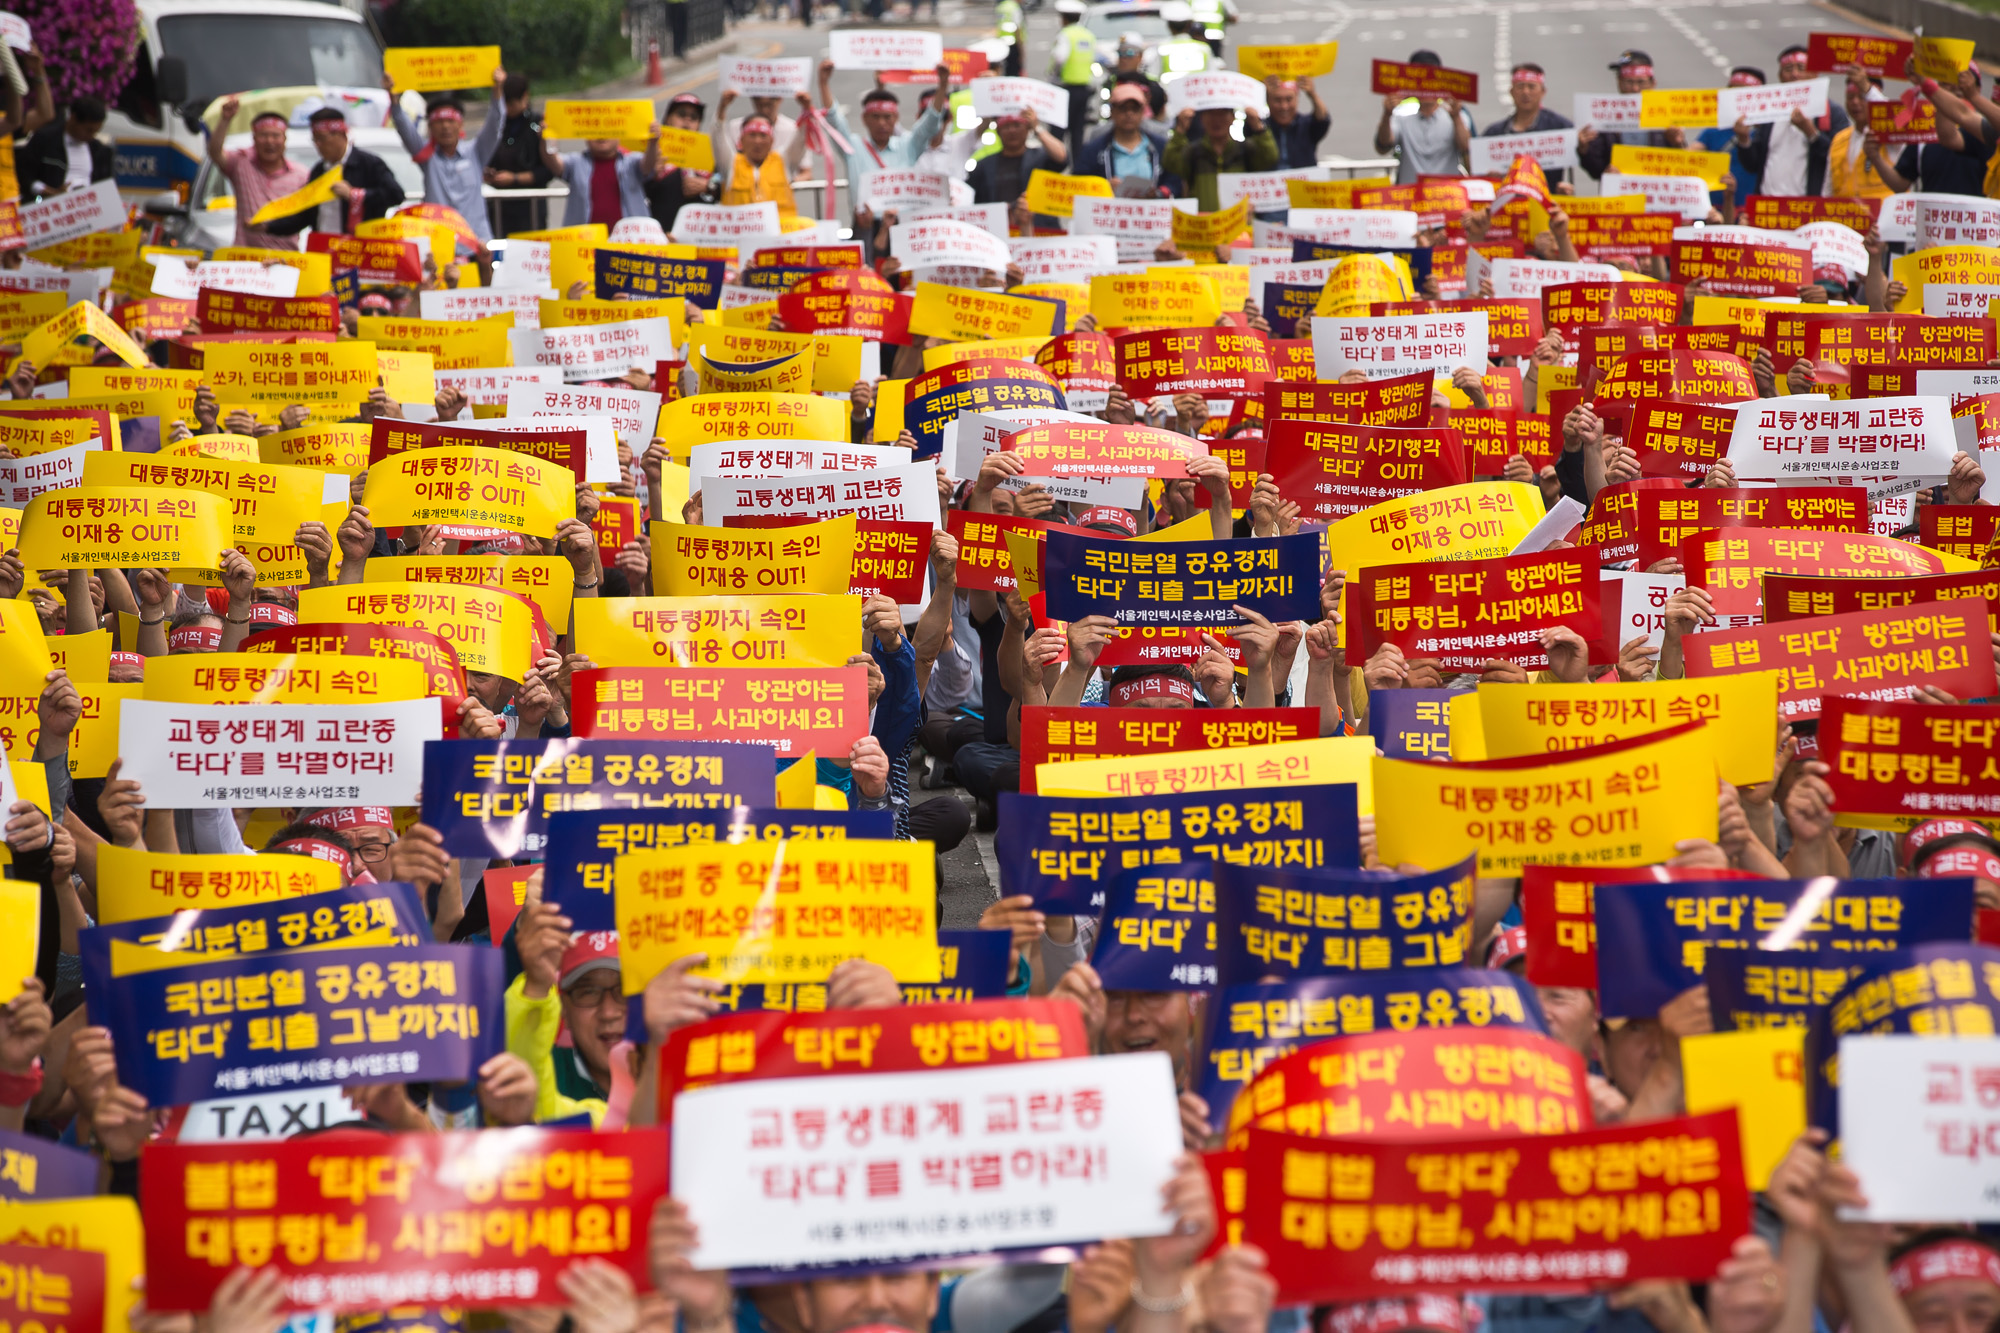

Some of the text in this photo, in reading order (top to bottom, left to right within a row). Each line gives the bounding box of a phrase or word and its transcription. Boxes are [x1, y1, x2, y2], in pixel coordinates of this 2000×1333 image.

[1680, 245, 1803, 268] 불법 '타다' 방관하는
[1733, 265, 1803, 284] 사과하세요!
[1124, 334, 1264, 360] 불법 '타다' 방관하는
[1820, 326, 1984, 344] 불법 '타다' 방관하는
[593, 345, 649, 362] 물러가라!
[1820, 348, 1984, 365] 대통령님, 사과하세요!
[213, 371, 247, 387] 쏘카,
[253, 371, 297, 386] 타다를
[1124, 354, 1270, 379] 대통령님, 사과하세요!
[1638, 358, 1750, 380] '타다' 방관하는
[544, 392, 641, 414] 공유경제 마피아
[691, 402, 808, 417] 대통령까지 속인
[1648, 410, 1682, 429] 불법
[1758, 407, 1924, 430] 교통생태계 교란종
[1304, 431, 1441, 459] 대국민 사기행각
[1645, 432, 1721, 458] 대통령님,
[1758, 433, 1926, 456] '타다'를 박멸하라!
[24, 457, 73, 480] 마피아
[129, 463, 277, 494] 대통령까지 속인
[401, 457, 542, 486] 대통령까지 속인
[1318, 458, 1423, 480] '타다' OUT!
[415, 482, 526, 507] 이재웅 OUT!
[736, 477, 903, 508] 교통생태계 교란종
[46, 498, 196, 518] 대통령까지 속인
[412, 509, 525, 527] 서울개인택시운송사업조합
[1096, 509, 1122, 521] 결단
[1370, 493, 1514, 535] 대통령까지 속인
[1659, 498, 1855, 520] 불법 '타다' 방관하는
[62, 523, 179, 544] 이재웅 OUT!
[963, 523, 998, 543] 불법
[1391, 521, 1504, 554] 이재웅 OUT!
[61, 550, 180, 563] 서울개인택시운송사업조합
[677, 535, 821, 561] 대통령까지 속인
[1703, 538, 1932, 572] 불법 '타다' 방관하는
[1085, 549, 1279, 575] 국민분열 공유경제
[405, 567, 549, 586] 대통령까지 속인
[688, 566, 807, 589] 이재웅 OUT!
[1071, 575, 1294, 601] '타다' 퇴출 그날까지!
[1374, 561, 1582, 601] 불법 '타다' 방관하는
[347, 594, 503, 624] 대통령까지 속인
[632, 608, 806, 634] 대통령까지 속인
[1375, 591, 1583, 632] 대통령님, 사과하세요!
[437, 623, 486, 644] OUT!
[1709, 614, 1966, 669] 불법 '타다' 방관하는
[652, 640, 785, 664] 이재웅 OUT!
[1833, 646, 1969, 683] 사과하세요!
[194, 668, 378, 695] 대통령까지 속인
[595, 678, 844, 702] 불법 '타다' 방관하는
[1119, 678, 1193, 700] 정치적 결단
[168, 719, 396, 744] 교통생태계 교란종
[596, 706, 845, 732] 대통령님, 사과하세요!
[1047, 720, 1298, 748] 불법 '타다' 방관하는
[168, 751, 393, 776] '타다'를 박멸하라!
[1106, 755, 1311, 796] 대통령까지 속인
[202, 786, 360, 800] 서울개인택시운송사업조합
[1440, 763, 1662, 813] 대통령까지 속인
[1049, 801, 1304, 842] 국민분열 공유경제
[165, 960, 458, 1017] 국민분열 공유경제
[147, 1005, 479, 1063] '타다' 퇴출 그날까지!
[685, 1018, 1062, 1076] 불법 '타다' 방관하는
[210, 1103, 326, 1138] TAXI
[1281, 1133, 1720, 1200] 불법 '타다' 방관하는
[1281, 1201, 1474, 1250] 대통령님,
[1485, 1187, 1721, 1246] 사과하세요!
